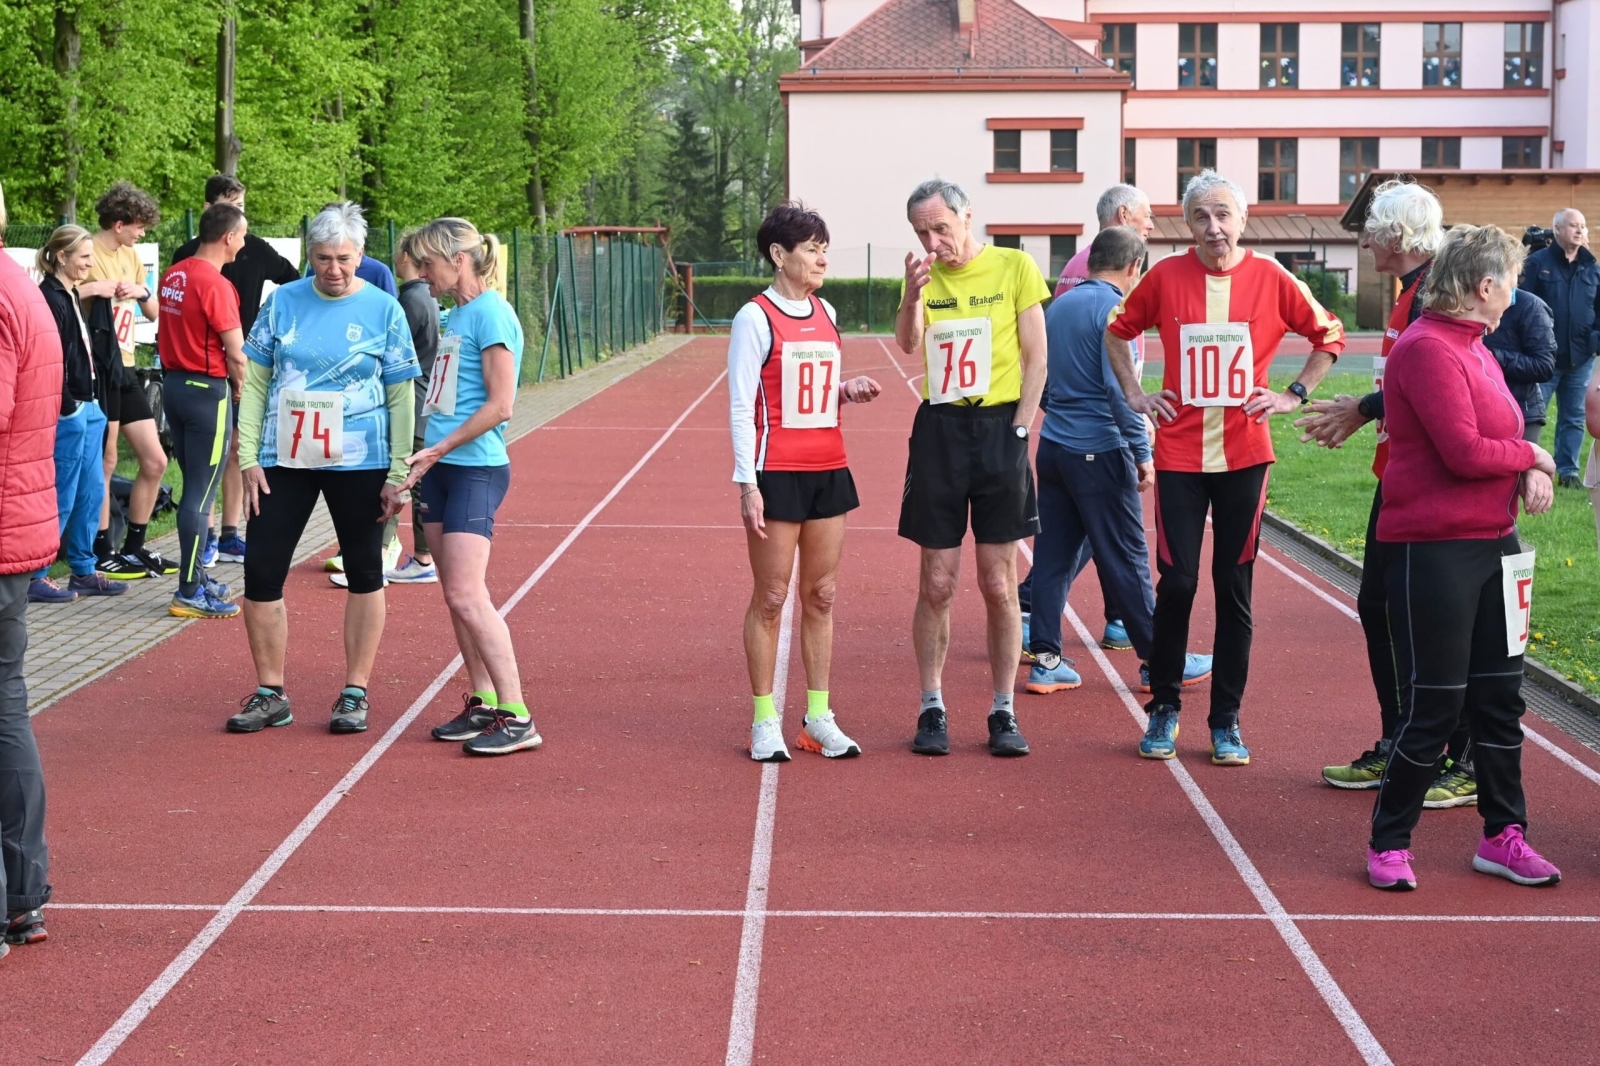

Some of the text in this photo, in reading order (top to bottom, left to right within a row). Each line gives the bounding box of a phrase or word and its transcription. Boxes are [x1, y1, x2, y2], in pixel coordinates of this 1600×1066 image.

[933, 328, 983, 341] PIVOVAR TRUTNOV
[1189, 334, 1243, 343] PIVOVAR TRUTNOV
[791, 351, 813, 359] PIVOVAR
[939, 338, 977, 394] 76
[797, 360, 833, 415] 87
[1186, 345, 1246, 399] 106
[285, 399, 334, 409] PIVOVAR TRUTNOV
[290, 410, 331, 459] 74
